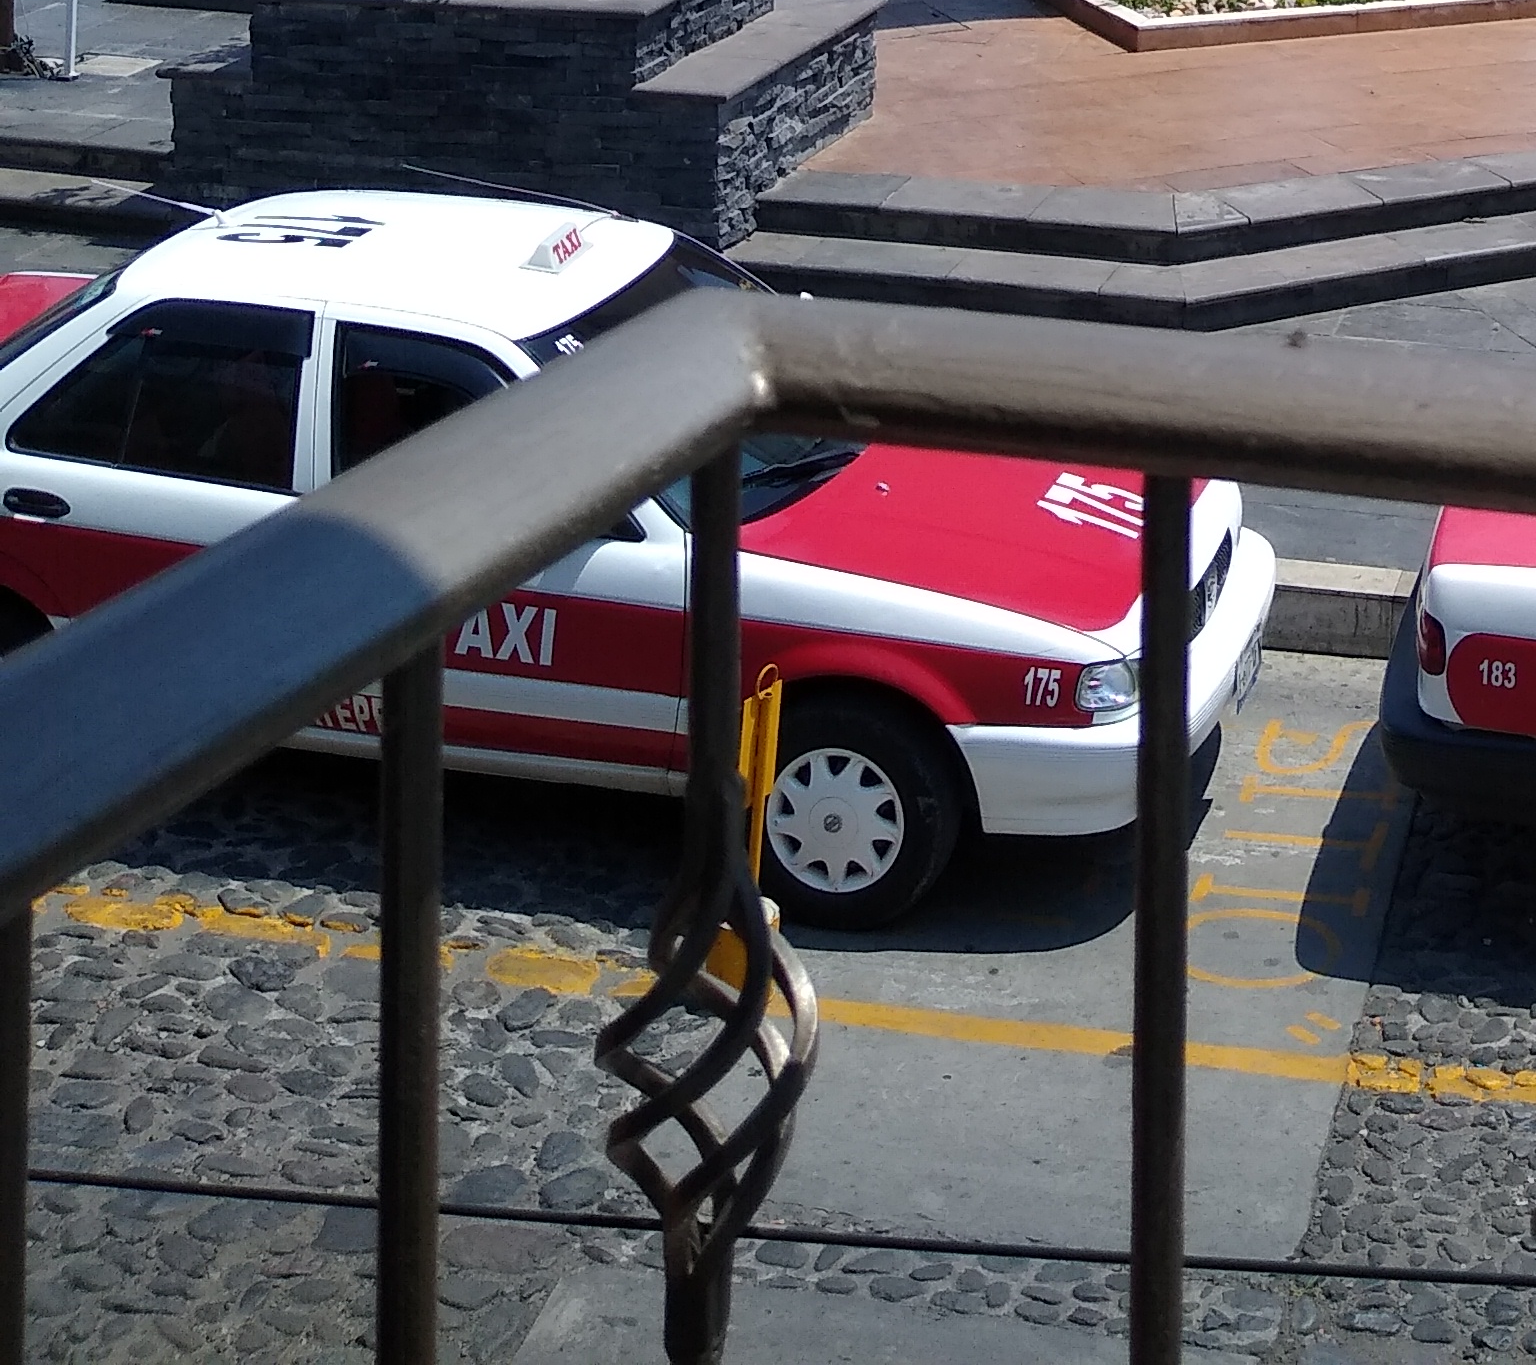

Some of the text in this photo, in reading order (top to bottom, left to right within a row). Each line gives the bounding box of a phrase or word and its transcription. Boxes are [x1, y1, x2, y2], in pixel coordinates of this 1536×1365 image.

[552, 227, 583, 264] TAXI
[454, 601, 557, 667] AXI
[1023, 666, 1062, 708] 175
[1478, 658, 1517, 690] 183
